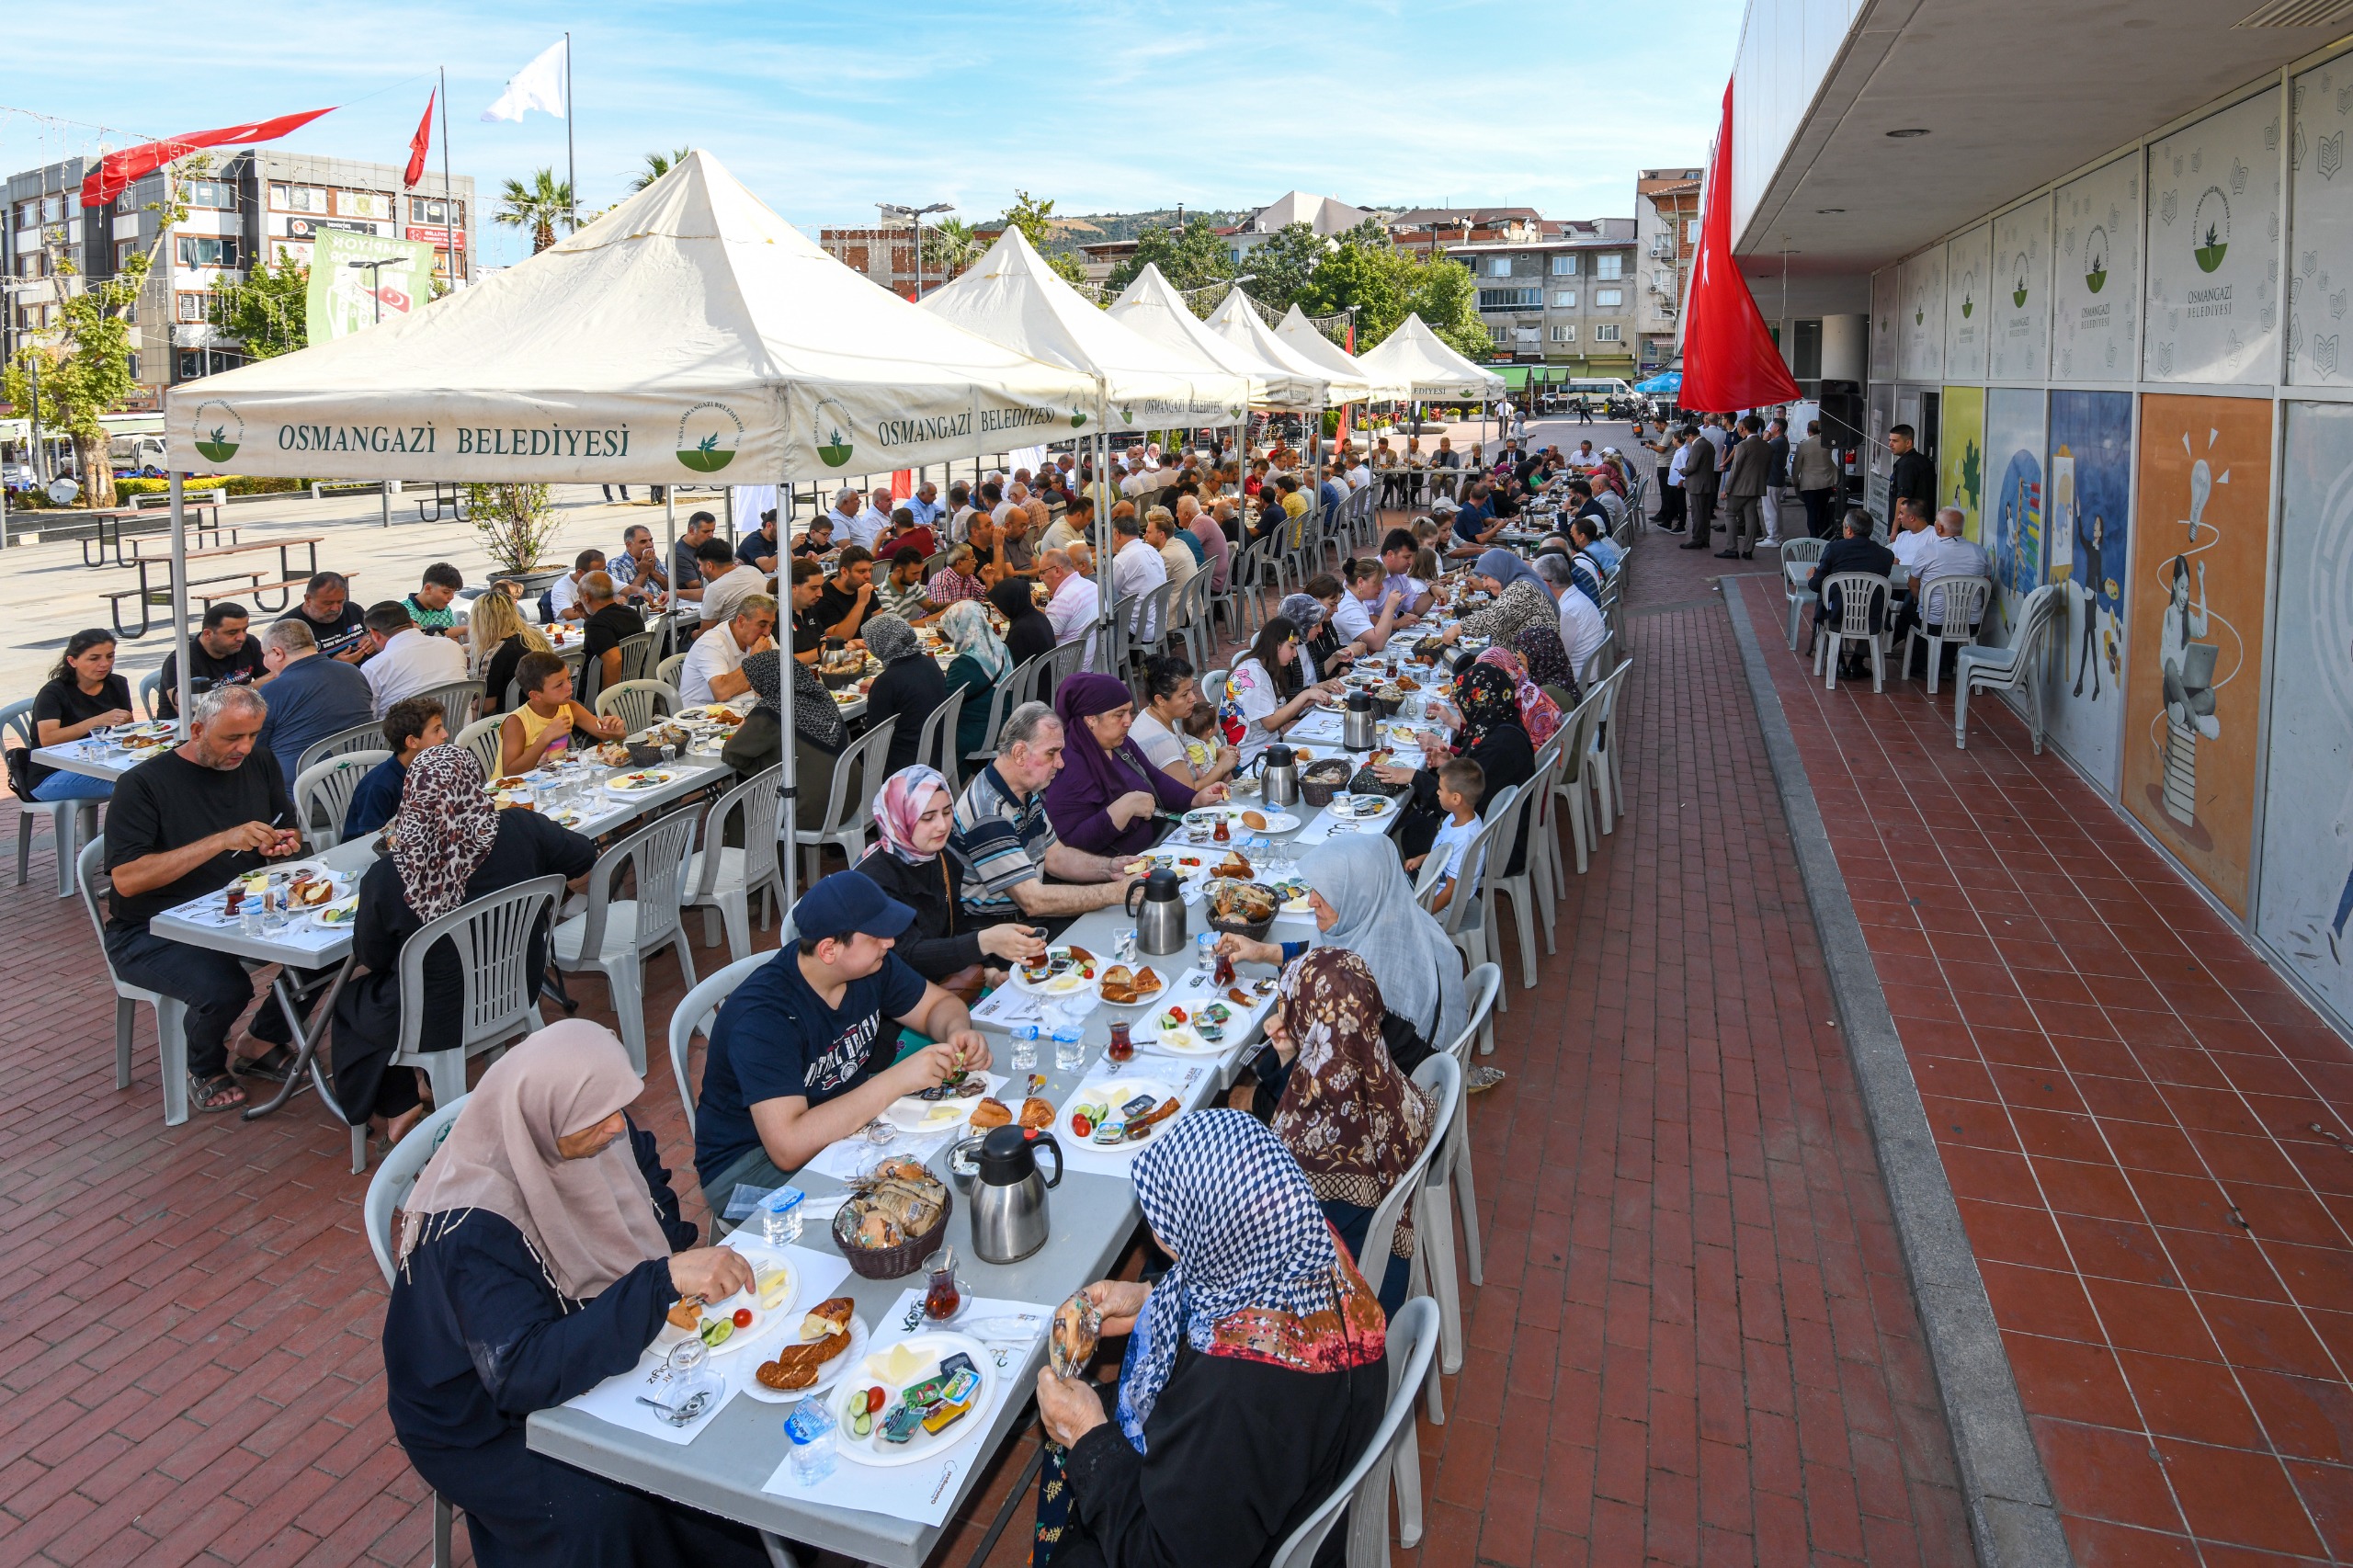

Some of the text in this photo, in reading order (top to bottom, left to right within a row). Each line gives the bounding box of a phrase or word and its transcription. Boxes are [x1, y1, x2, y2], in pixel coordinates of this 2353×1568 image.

[2188, 283, 2233, 304] OSMANGAZİ
[2188, 301, 2232, 319] BELEDİYESİ
[1144, 394, 1223, 415] OSMANGAZİ BELEDİYESİ
[878, 403, 1056, 447] OSMANGAZİ BELEDİYESİ
[278, 421, 631, 458] OSMANGAZİ BELEDİYESİ
[676, 426, 685, 449] BURSA
[323, 629, 365, 649] BMW Motorsport
[930, 1471, 952, 1506] Osmangazi
